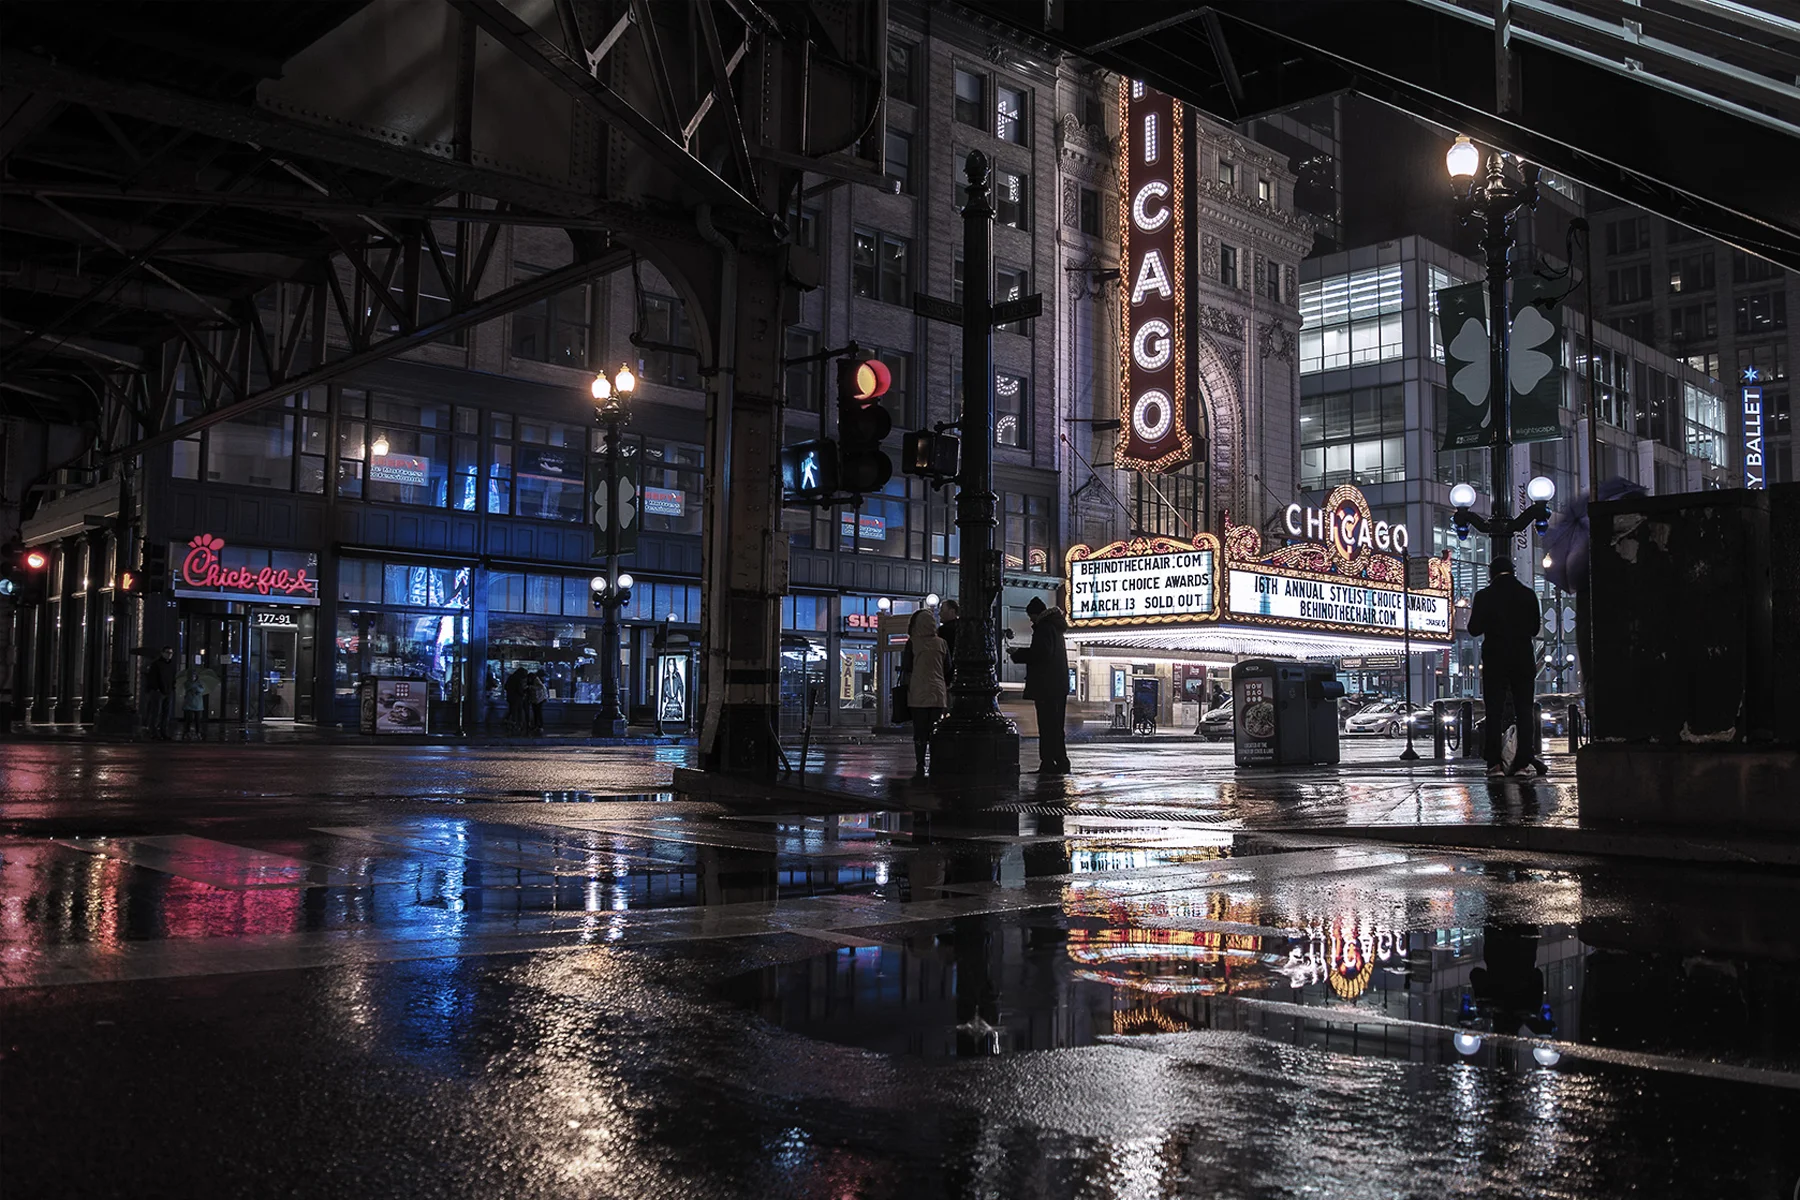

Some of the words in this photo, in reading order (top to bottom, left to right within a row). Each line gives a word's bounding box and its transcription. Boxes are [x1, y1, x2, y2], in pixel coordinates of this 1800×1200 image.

[1132, 79, 1173, 442] ICAGO
[1744, 389, 1763, 466] BALLET
[1746, 472, 1763, 490] Y
[1286, 503, 1409, 554] CHICAGO
[183, 545, 314, 595] Chick-fil-A
[1080, 554, 1202, 576] BEHINDTHECHAIR.COM
[1075, 580, 1118, 594] STYLIST
[1122, 576, 1160, 592] CHOICE
[1164, 573, 1210, 589] AWARDS
[1254, 575, 1279, 596] 16TH
[1284, 579, 1325, 601] ANNUAL
[1329, 586, 1369, 606] STYLIST
[1371, 591, 1403, 610] CHOICE
[1080, 598, 1119, 613] MARCH
[1125, 597, 1136, 611] 13
[1144, 595, 1174, 609] SOLD
[1178, 594, 1203, 608] OUT
[1299, 600, 1397, 626] BEHINDTHECHAIR.COM
[257, 613, 291, 624] 177-91
[848, 614, 879, 628] SLE
[844, 656, 853, 699] SALE
